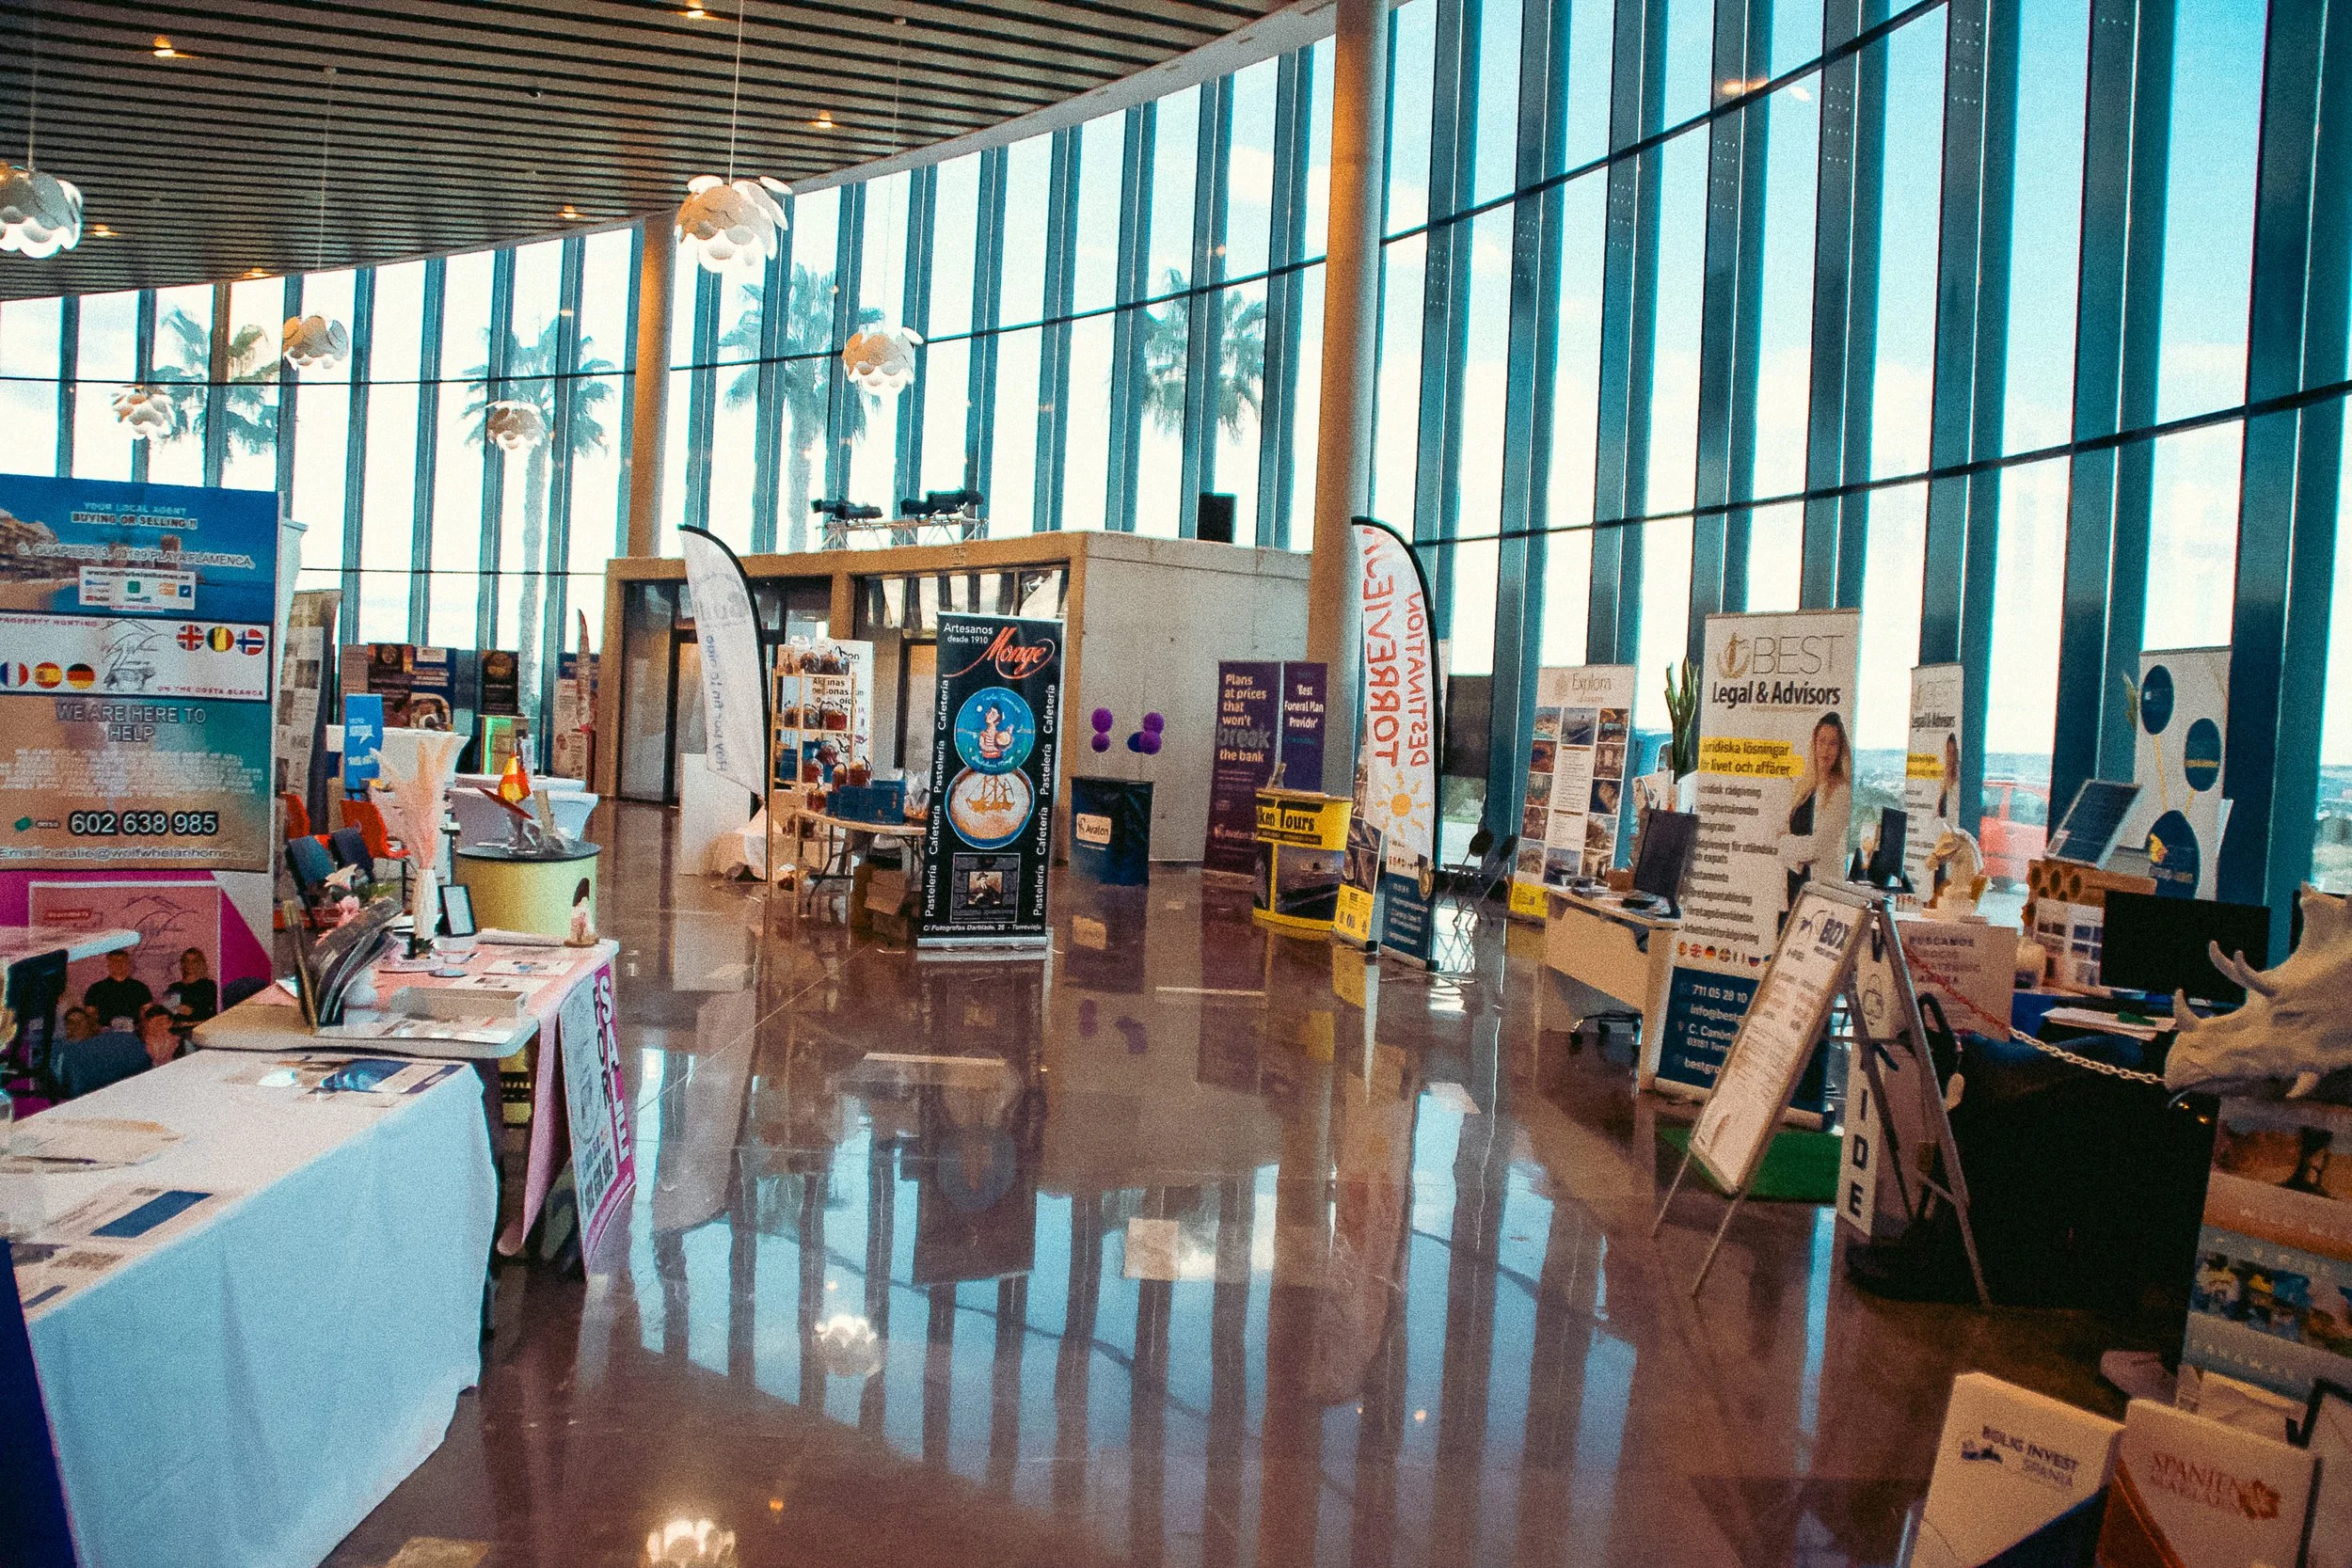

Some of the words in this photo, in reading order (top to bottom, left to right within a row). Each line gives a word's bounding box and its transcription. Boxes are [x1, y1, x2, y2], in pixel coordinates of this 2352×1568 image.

[72, 513, 116, 523] BUYING
[120, 515, 135, 525] OR
[138, 515, 186, 528] SELLING
[944, 622, 993, 635] Artesanos
[946, 635, 969, 643] desde
[971, 636, 989, 644] 1910
[1753, 635, 1844, 675] BEST
[1226, 673, 1253, 686] Plans
[1572, 673, 1612, 695] Explora
[1225, 689, 1234, 699] at
[1236, 688, 1267, 700] prices
[1712, 680, 1754, 709] Legal
[1756, 681, 1770, 704] &
[1772, 680, 1841, 705] Advisors
[56, 705, 88, 721] WE
[89, 707, 126, 722] ARE
[131, 707, 180, 722] HERE
[184, 708, 207, 723] TO
[938, 679, 949, 731] Cafetería
[1043, 684, 1056, 735] Cafetería
[1223, 701, 1245, 713] that
[1284, 700, 1309, 712] Funeral
[1310, 701, 1325, 713] Plan
[1222, 715, 1252, 727] won't
[108, 725, 155, 743] HELP
[1216, 722, 1271, 750] break
[1219, 749, 1237, 761] the
[1239, 751, 1264, 764] bank
[1743, 741, 1790, 758] lösningar
[933, 740, 946, 794] Pastelería
[1040, 743, 1052, 796] Pastelería
[1710, 759, 1735, 774] livet
[1735, 761, 1754, 774] och
[71, 813, 116, 834] 602
[123, 813, 167, 834] 638
[174, 813, 217, 834] 985
[1278, 801, 1316, 832] Tours
[929, 805, 941, 855] Cafetería
[1036, 807, 1049, 856] Cafetería
[1085, 824, 1109, 836] Avalon
[925, 864, 937, 917] Pastelería
[1033, 864, 1044, 916] Pastelería
[931, 925, 965, 933] Fotografos
[1818, 917, 1851, 950] BOX
[1692, 984, 1707, 997] 711
[1708, 987, 1721, 999] 05
[1723, 990, 1735, 1002] 28
[1689, 1022, 1698, 1035] C.
[593, 986, 612, 1110] FOR
[598, 974, 630, 1164] SALE
[1684, 1056, 1721, 1075] bestgro
[2026, 1443, 2079, 1473] INVEST
